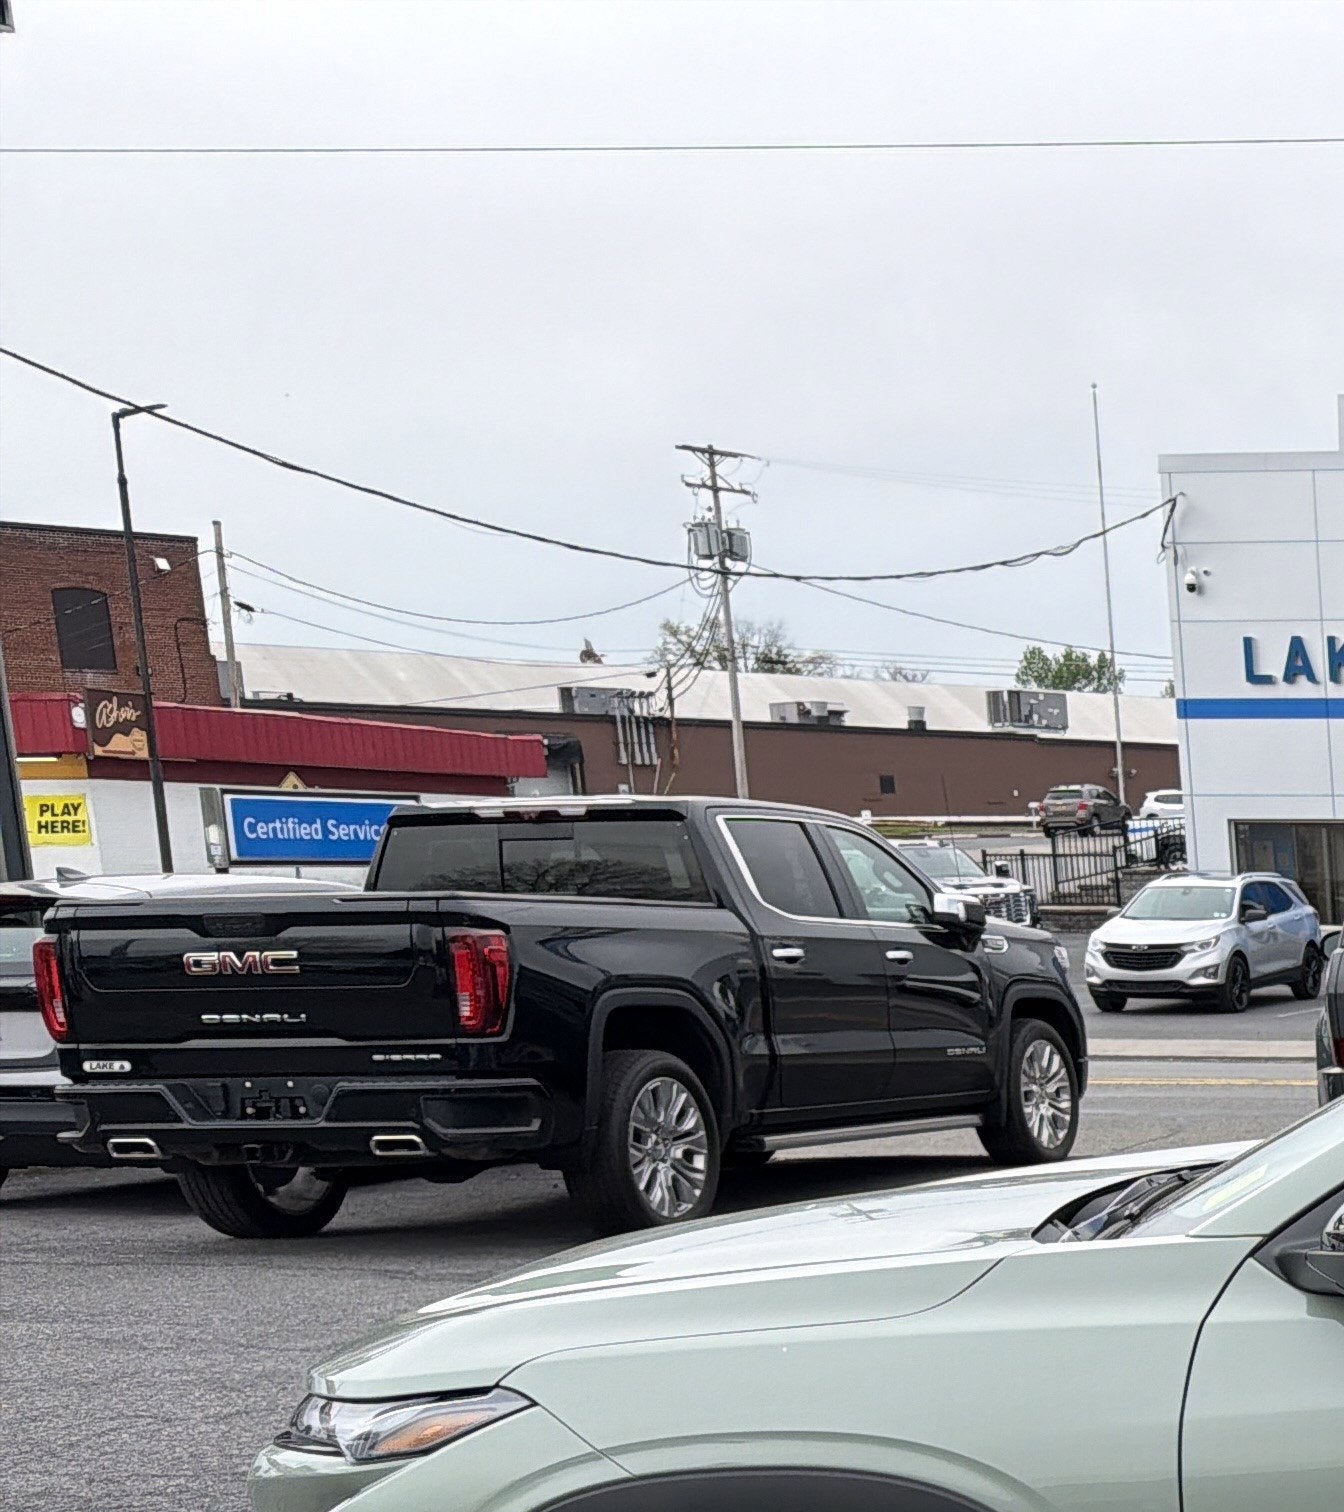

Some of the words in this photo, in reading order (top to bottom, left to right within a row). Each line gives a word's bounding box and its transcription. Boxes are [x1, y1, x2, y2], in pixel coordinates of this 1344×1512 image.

[38, 802, 82, 818] PLAY
[37, 819, 87, 834] HERE!
[243, 817, 323, 840] Certified
[183, 951, 300, 976] GMC
[201, 1013, 307, 1024] DENALI
[89, 1062, 115, 1071] LAKE
